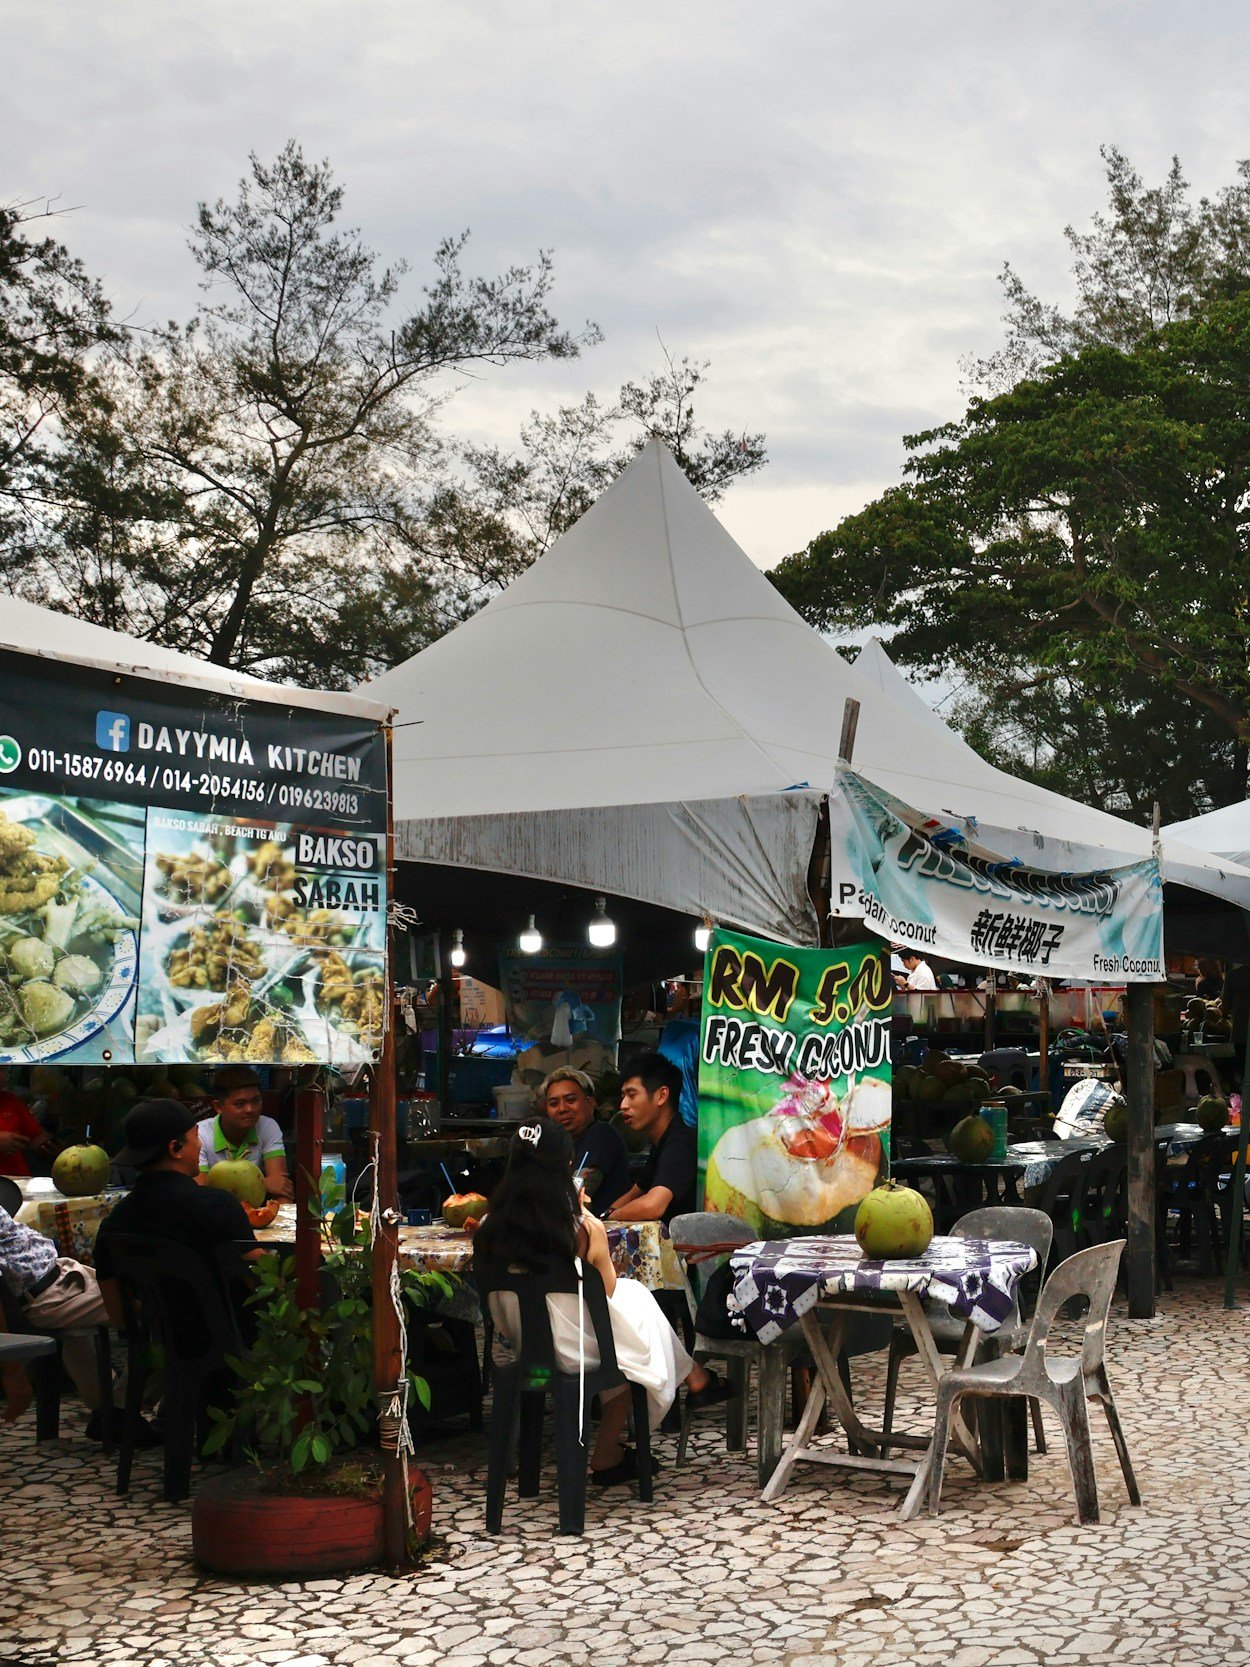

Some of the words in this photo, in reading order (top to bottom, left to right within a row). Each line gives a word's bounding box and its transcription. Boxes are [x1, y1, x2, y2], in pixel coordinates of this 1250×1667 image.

[138, 723, 255, 766] DAYYMIA
[267, 744, 362, 782] KITCHEN
[28, 748, 147, 786] 011-15876964
[162, 769, 265, 802] 014-2054156
[279, 785, 359, 814] 0196239813
[154, 817, 186, 830] BAKSO
[224, 827, 255, 839] BEACH
[299, 834, 374, 869] BAKSO
[292, 877, 379, 912] SABAH
[970, 909, 1065, 965] 新鲜椰子
[1093, 954, 1120, 972] Fresh
[708, 945, 800, 1023] RM
[703, 1015, 796, 1077] FRESH
